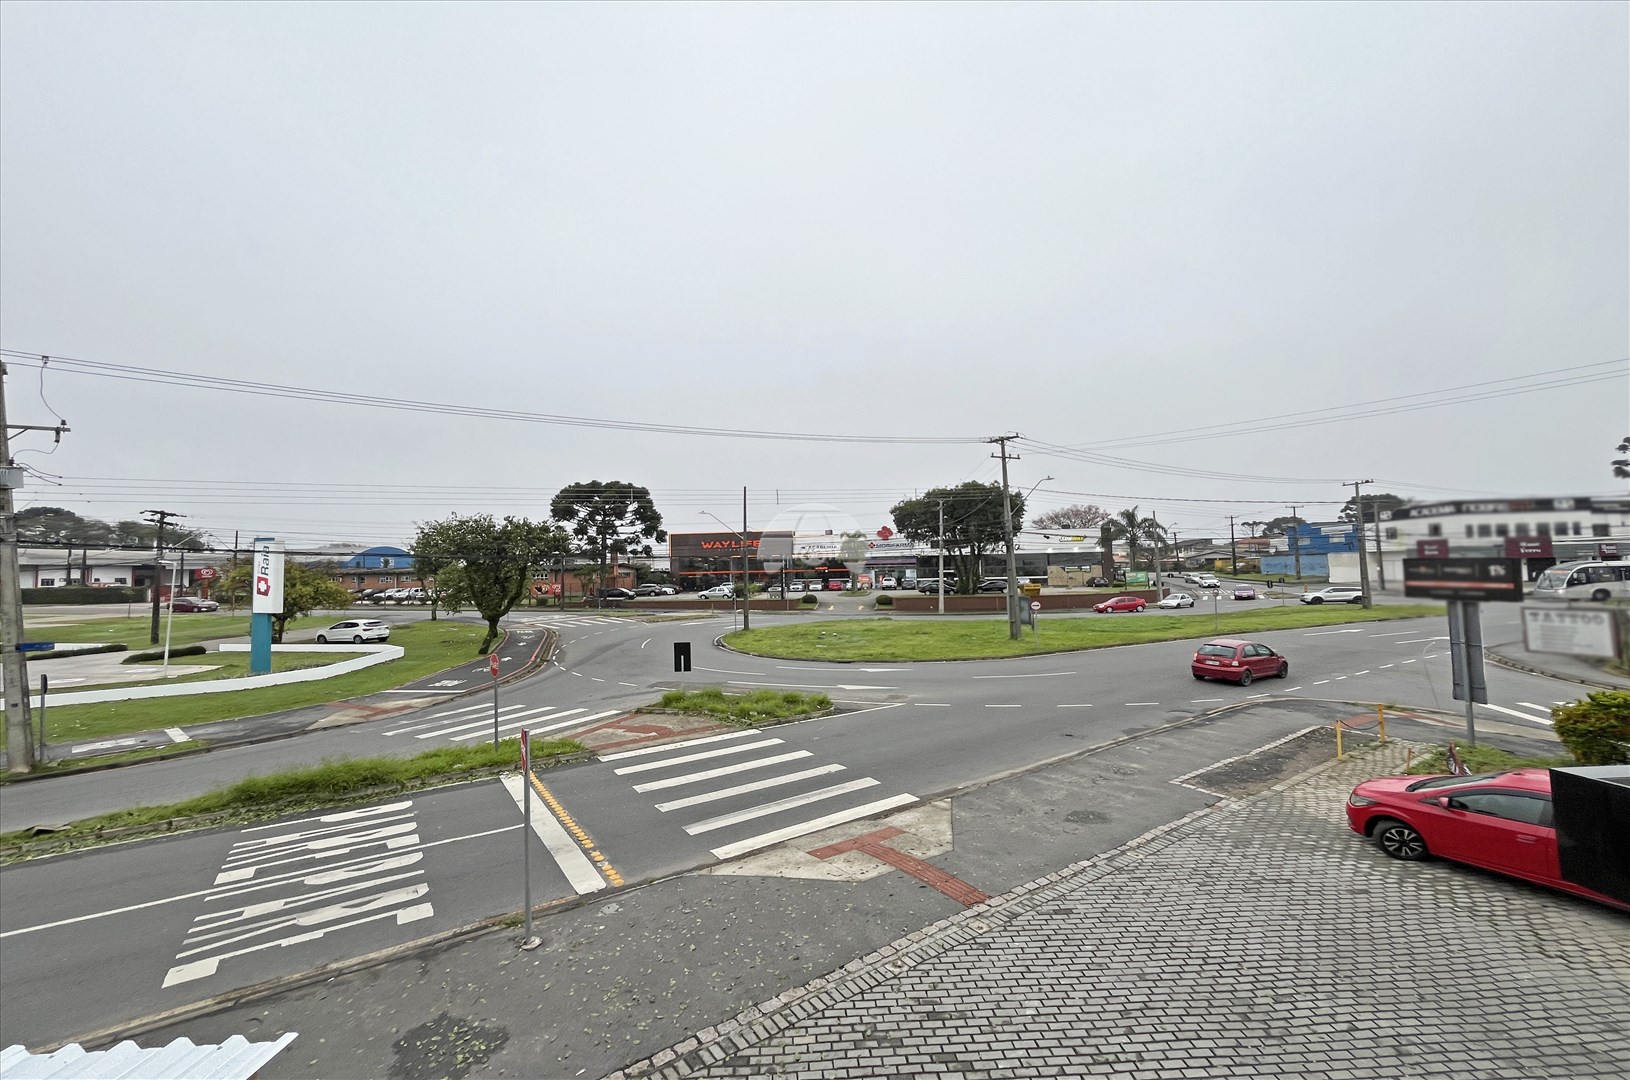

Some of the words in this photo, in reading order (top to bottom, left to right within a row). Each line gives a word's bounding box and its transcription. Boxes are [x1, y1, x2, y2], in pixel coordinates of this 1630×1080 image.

[701, 540, 761, 549] WAYLIFE
[260, 545, 270, 576] Raia
[1528, 611, 1605, 626] TATTOO
